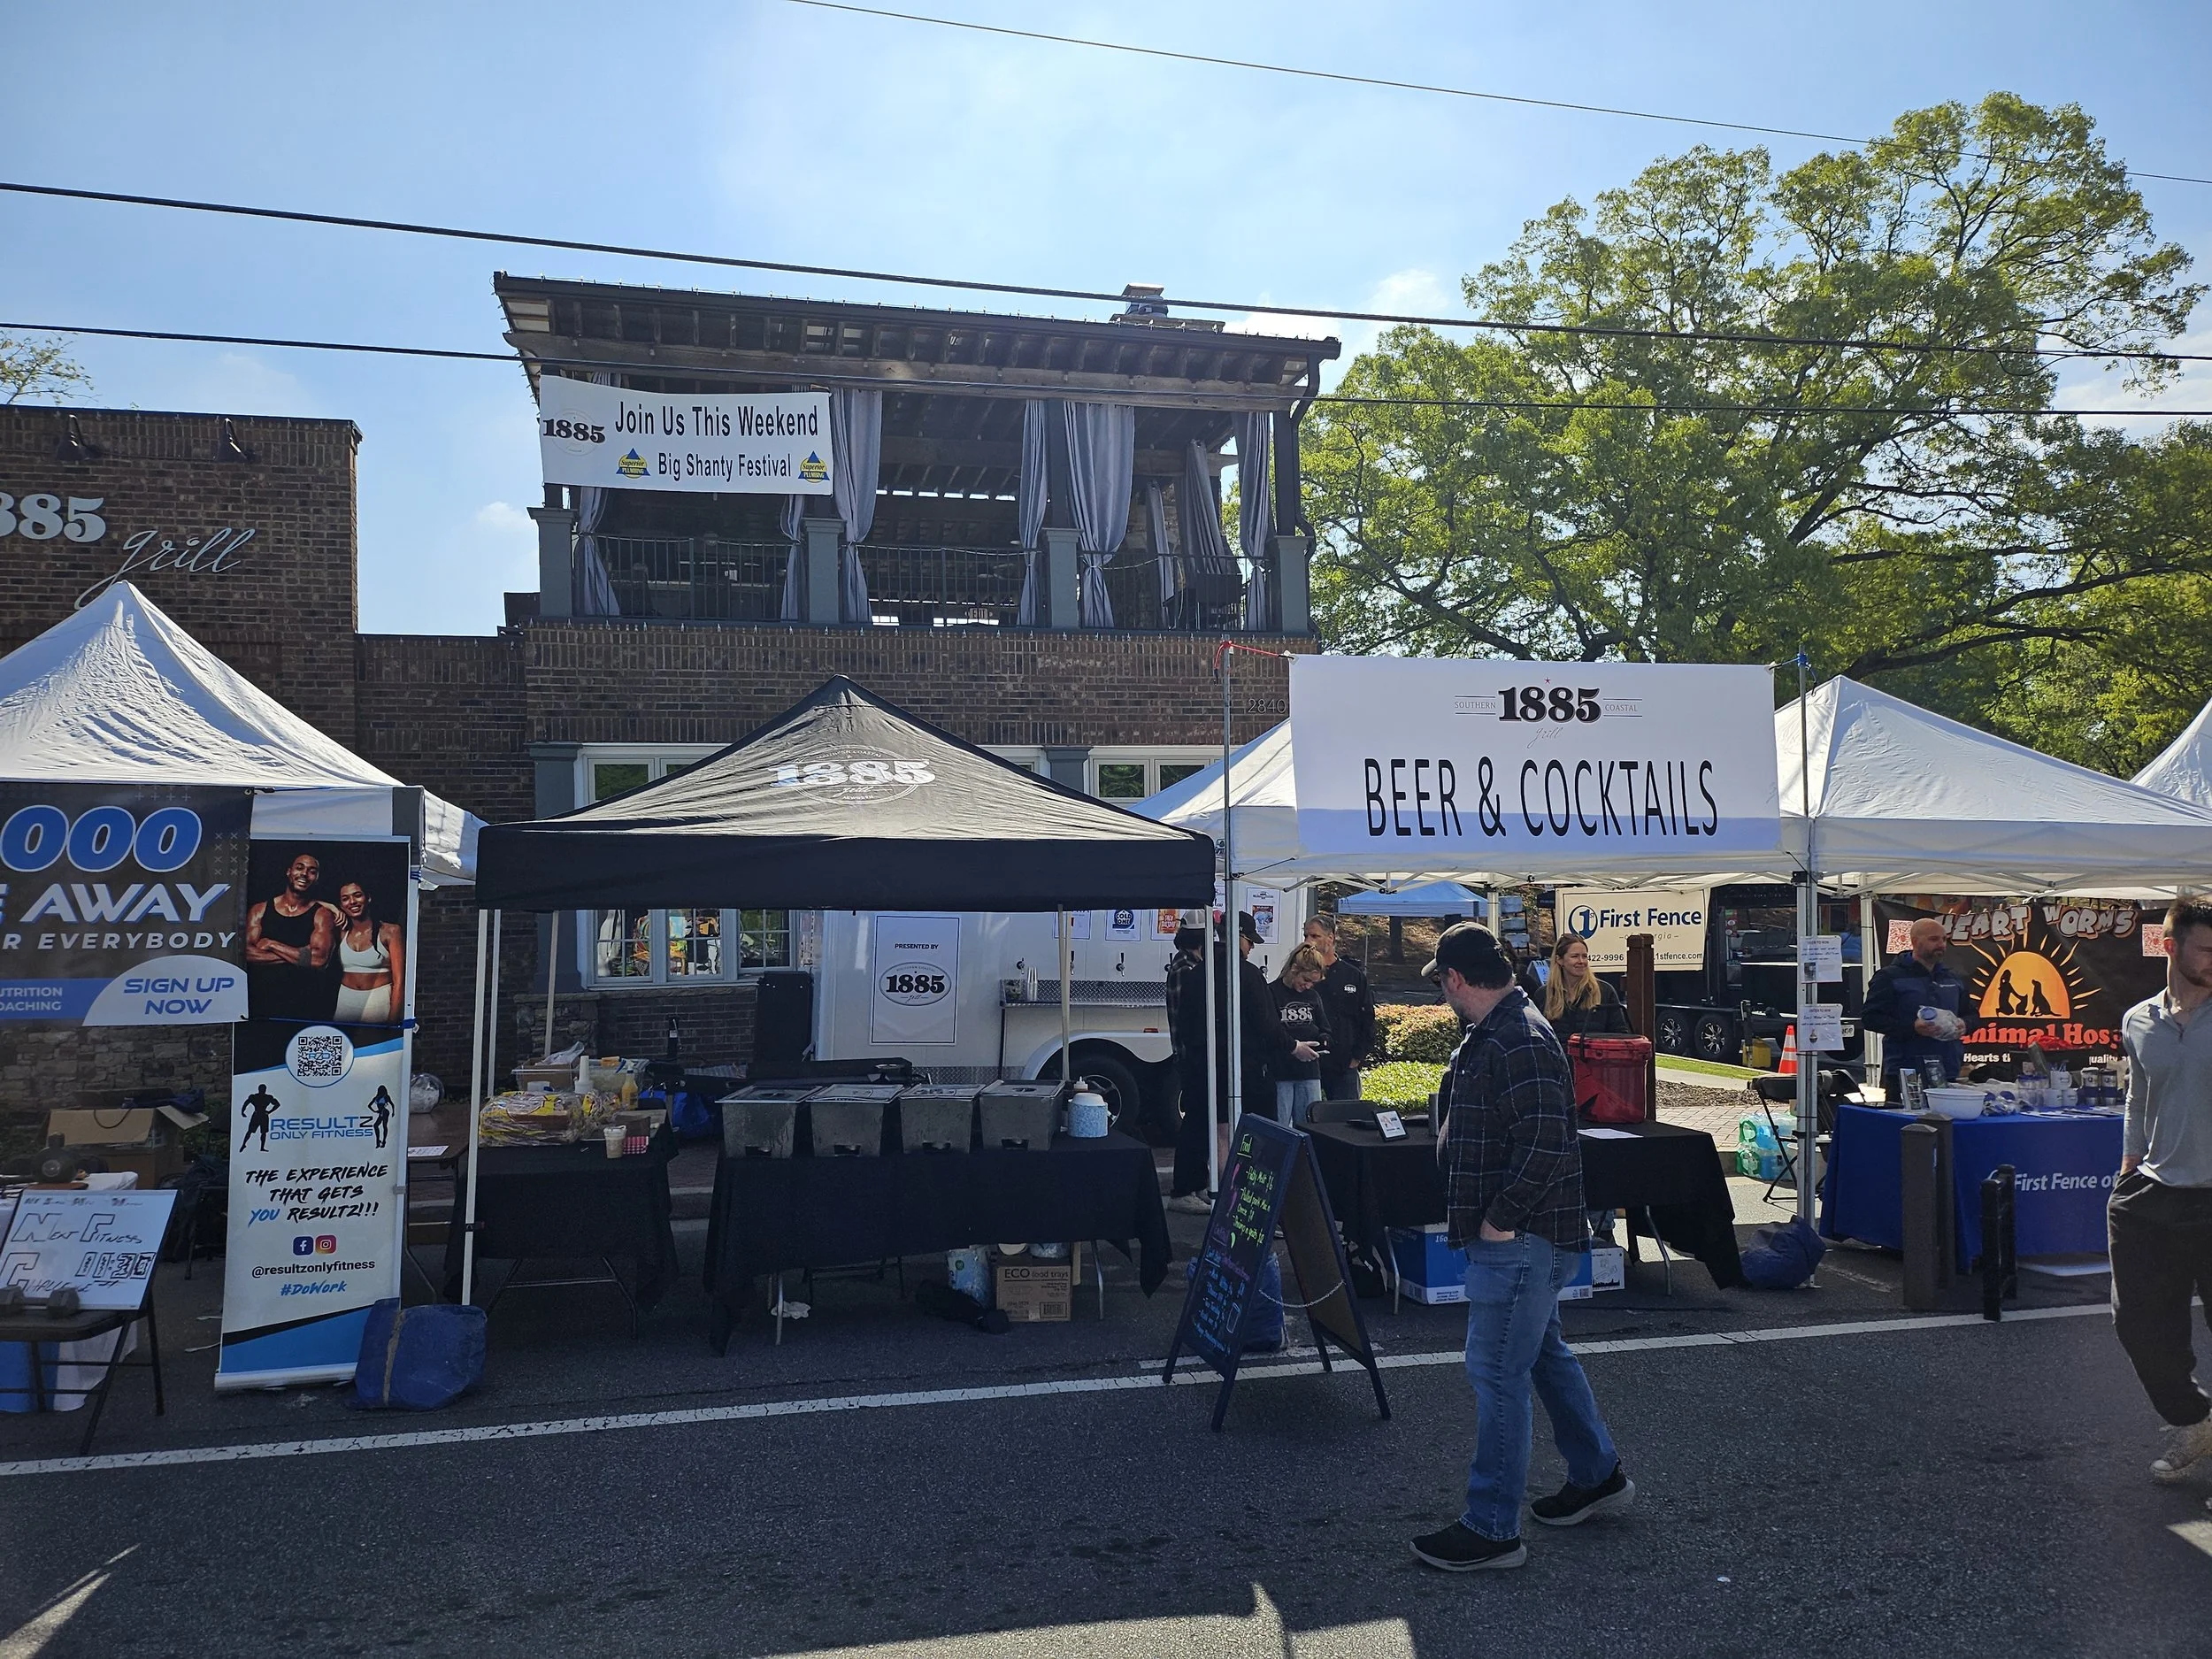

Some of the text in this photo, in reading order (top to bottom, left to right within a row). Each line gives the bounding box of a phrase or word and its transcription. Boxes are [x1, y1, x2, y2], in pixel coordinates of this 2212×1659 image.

[615, 401, 818, 436] Join Us This Weekend
[542, 419, 606, 443] 1885
[658, 452, 791, 482] Big Shanty Festival
[1248, 698, 1286, 714] 2840
[1498, 687, 1601, 723] 1885
[1527, 726, 1563, 749] grill
[767, 760, 936, 787] 1885
[1363, 756, 1717, 837] BEER & COCKTAILS
[19, 883, 231, 924] AWAY
[1600, 909, 1640, 927] First
[1647, 908, 1701, 926] Fence
[1934, 905, 2135, 941] HEART WORMS
[38, 933, 236, 949] EVERYBODY
[124, 978, 234, 994] SIGN UP
[886, 974, 945, 994] 1885
[144, 999, 212, 1015] NOW
[1280, 1007, 1313, 1021] 1885
[1963, 1053, 2000, 1063] Hearts
[270, 1116, 373, 1131] RESULTZ
[270, 1128, 373, 1140] ONLY FITNESS
[245, 1161, 388, 1188] THE EXPERIENCE
[2015, 1173, 2047, 1192] First
[2051, 1173, 2098, 1191] Fence
[270, 1185, 365, 1205] THAT GETS
[248, 1202, 380, 1228] YOU RESULTZ!!!
[251, 1260, 376, 1279] @resultzonlyfitness
[1004, 1268, 1068, 1279] ECO food trays
